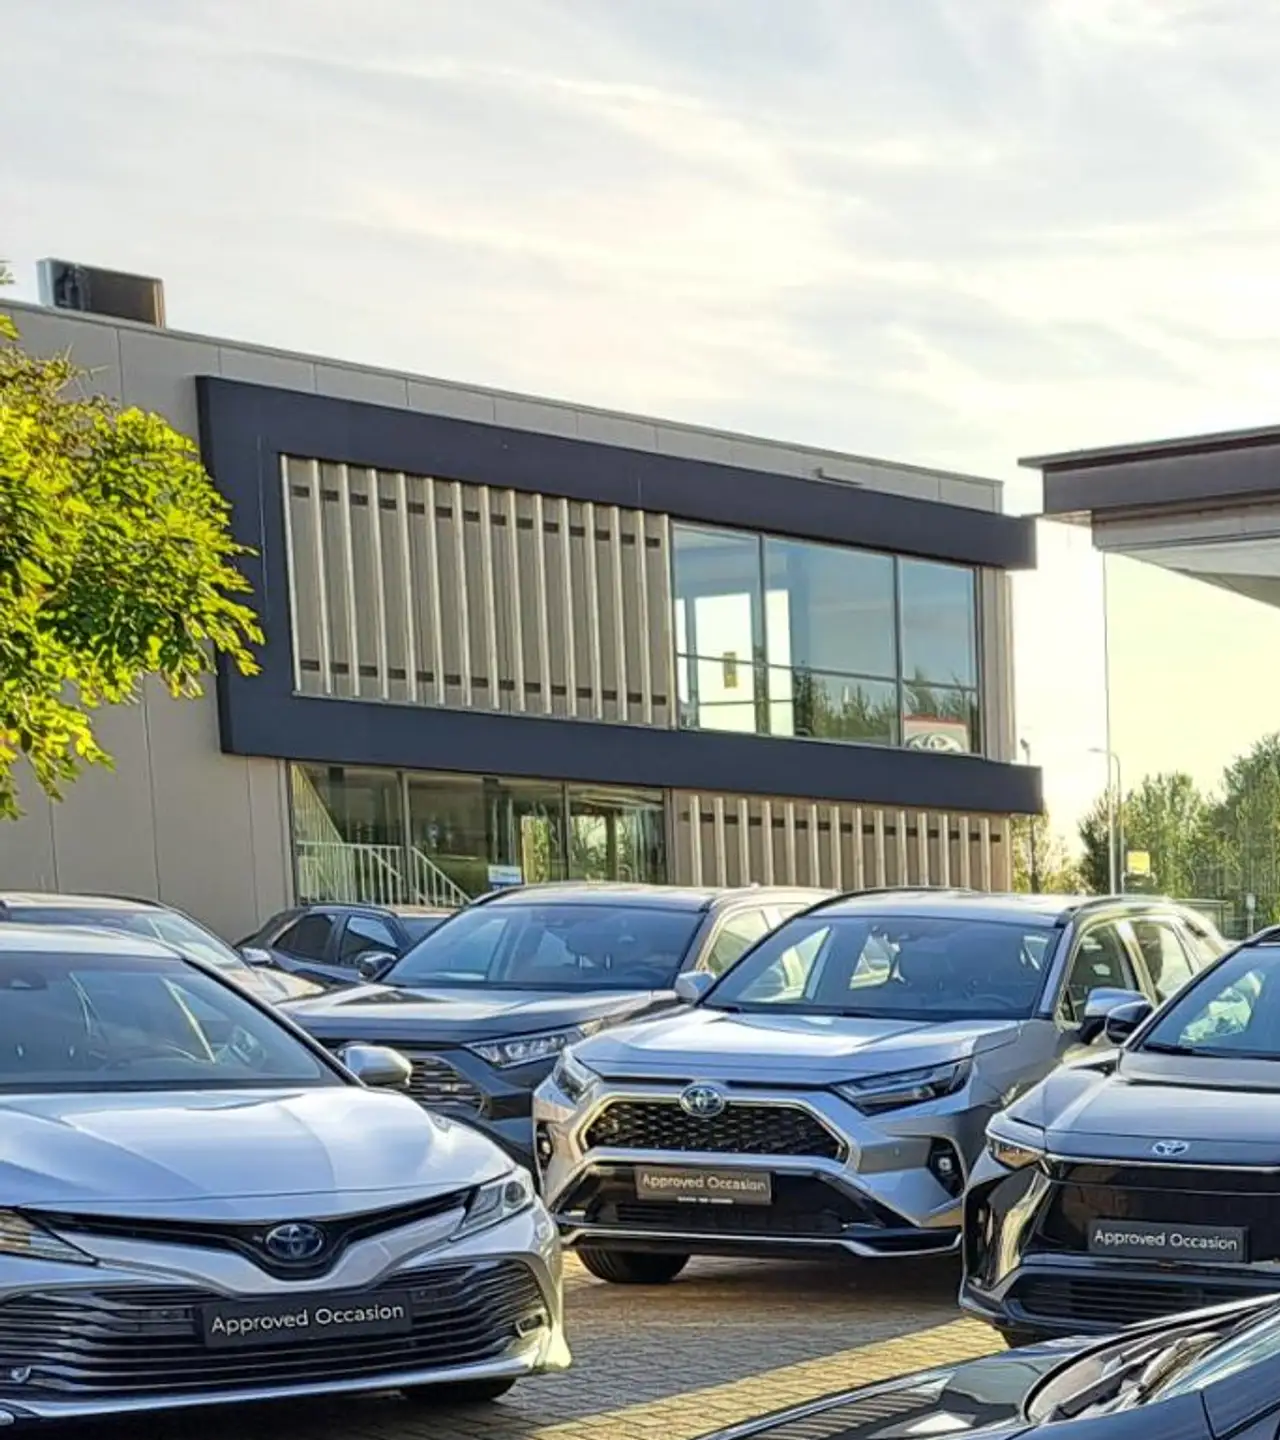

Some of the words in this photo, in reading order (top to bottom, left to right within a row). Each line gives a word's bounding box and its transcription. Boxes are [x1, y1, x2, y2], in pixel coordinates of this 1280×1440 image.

[643, 1173, 705, 1189] Approved
[707, 1175, 767, 1191] Occasion
[1094, 1229, 1166, 1247] Approved
[1170, 1232, 1237, 1251] Occasion
[211, 1309, 309, 1336] Approved
[315, 1303, 405, 1325] Occasion
